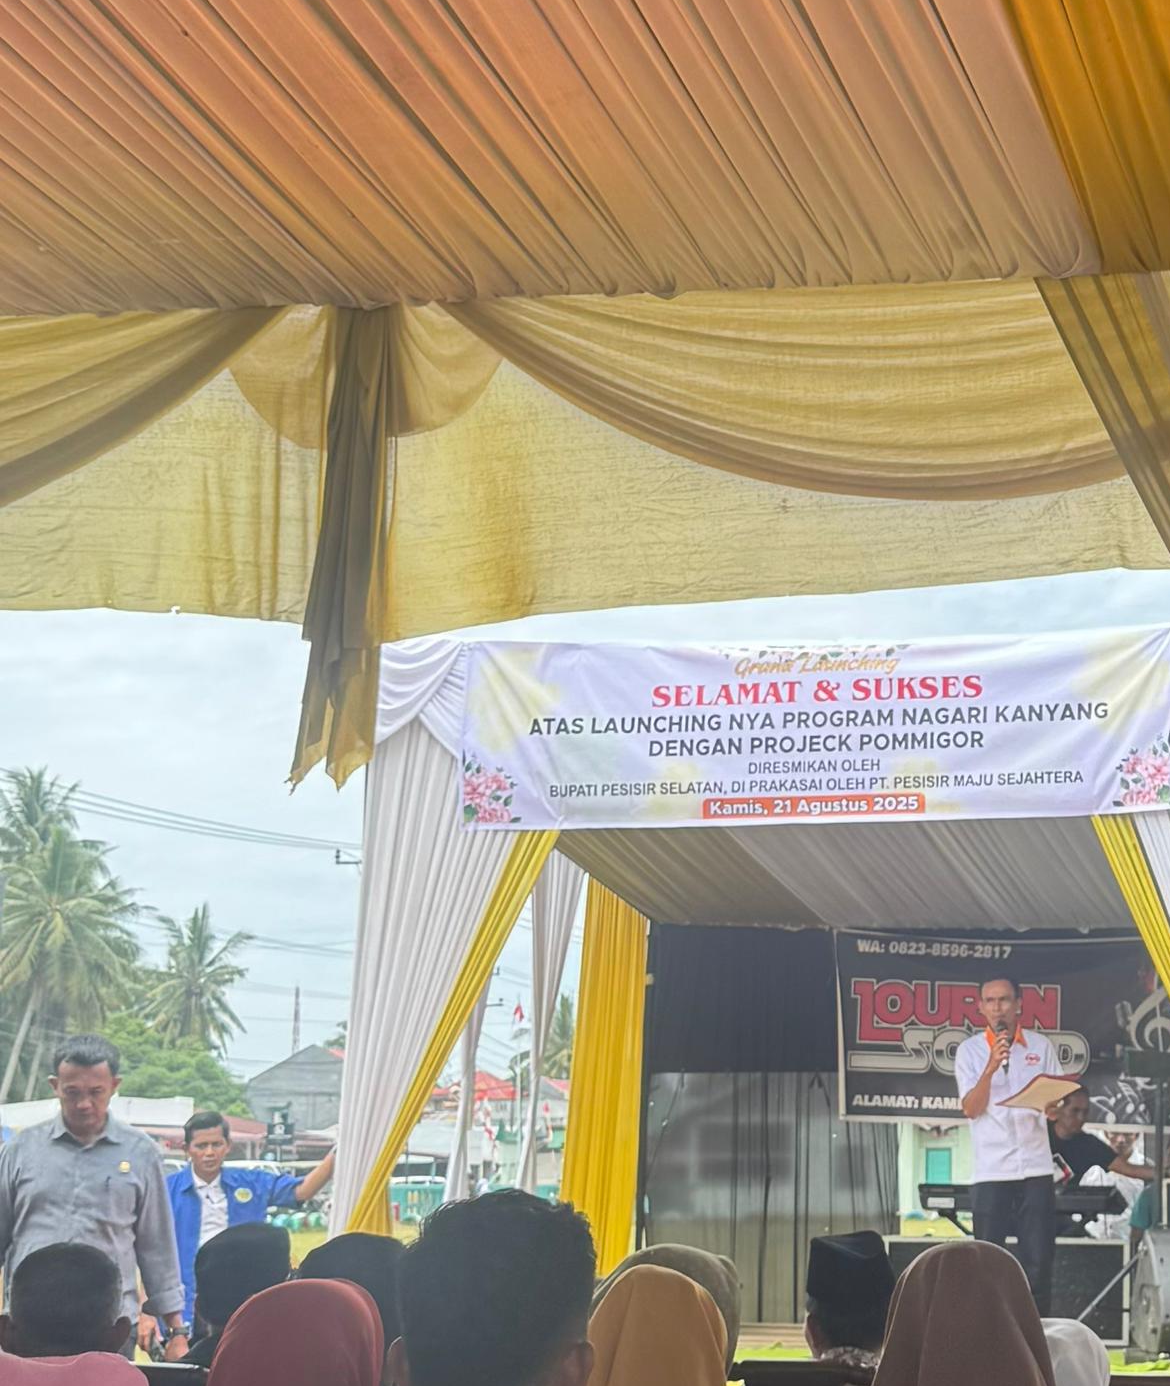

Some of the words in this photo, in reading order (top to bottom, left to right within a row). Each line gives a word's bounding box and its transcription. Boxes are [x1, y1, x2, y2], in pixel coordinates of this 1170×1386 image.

[798, 653, 899, 675] Launching
[652, 681, 802, 708] SELAMAT
[813, 679, 841, 702] &
[852, 675, 983, 701] SUKSES
[529, 718, 584, 735] ATAS
[591, 714, 722, 734] LAUNCHING
[729, 713, 775, 730] NYA
[783, 709, 894, 729] PROGRAM
[902, 706, 988, 726] NAGARI
[995, 702, 1108, 723] KANYANG
[649, 738, 743, 757] DENGAN
[750, 734, 852, 754] PROJECK
[859, 731, 984, 751] POMMIGOR
[748, 760, 838, 775] DIRESMIKAN
[841, 759, 880, 772] OLEH
[550, 784, 598, 797] BUPATI
[601, 782, 656, 796] PESISIR
[660, 781, 727, 795] SELATAN,
[731, 781, 745, 793] DI
[750, 778, 823, 792] PRAKASAI
[826, 778, 865, 791] OLEH
[869, 777, 890, 789] PT.
[894, 775, 950, 788] PESISIR
[953, 774, 993, 787] MAJU
[997, 771, 1084, 785] SEJAHTERA
[709, 800, 769, 816] Kamis,
[773, 801, 792, 813] 21
[797, 798, 868, 814] Agustus
[873, 796, 918, 811] 2025
[857, 939, 885, 952] WA:
[851, 978, 1061, 1044] LOURN
[852, 1094, 919, 1109] ALAMAT:
[921, 1096, 962, 1110] KAM
